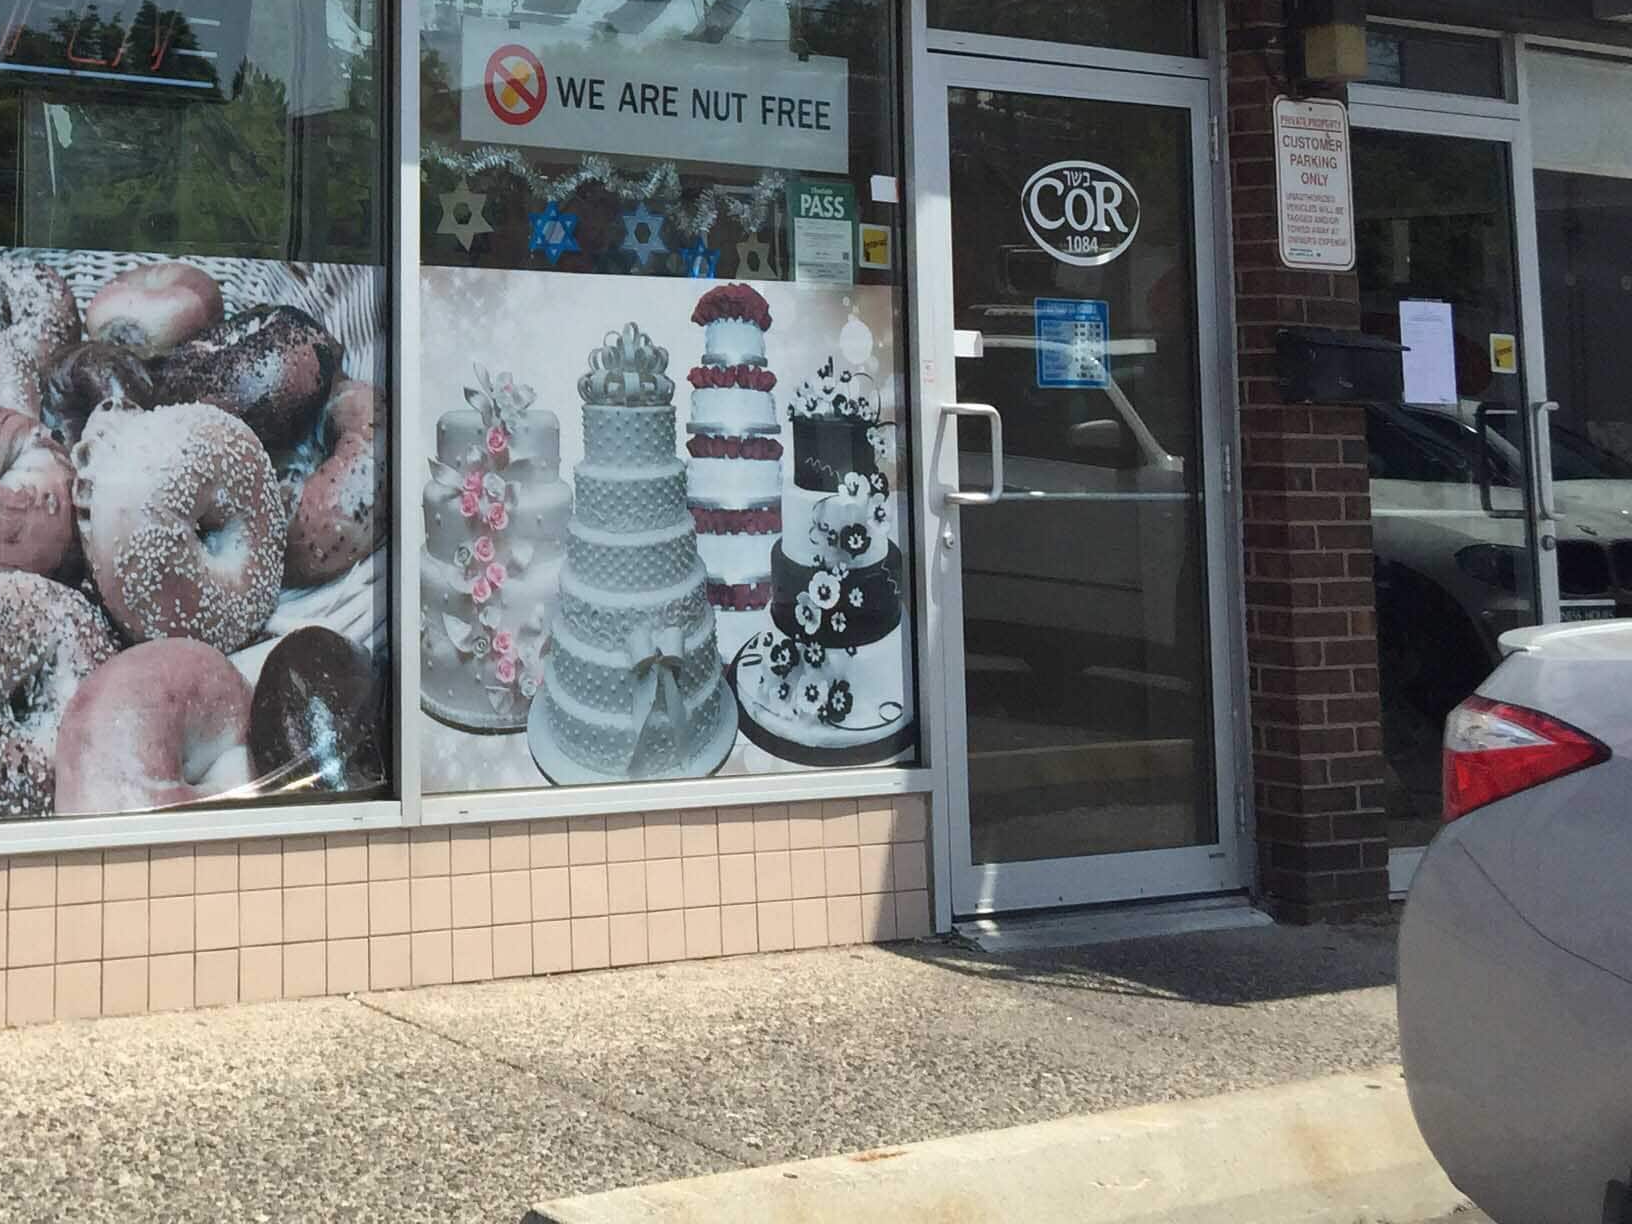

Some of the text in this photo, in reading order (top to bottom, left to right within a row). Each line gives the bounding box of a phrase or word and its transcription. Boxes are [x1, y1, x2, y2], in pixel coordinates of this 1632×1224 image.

[556, 76, 832, 131] WE ARE NUT FREE
[1282, 135, 1343, 152] CUSTOMER
[1290, 153, 1338, 169] PARKING
[1301, 172, 1329, 186] ONLY
[800, 194, 845, 218] PASS
[1030, 177, 1129, 232] COR
[1066, 235, 1099, 253] 1084
